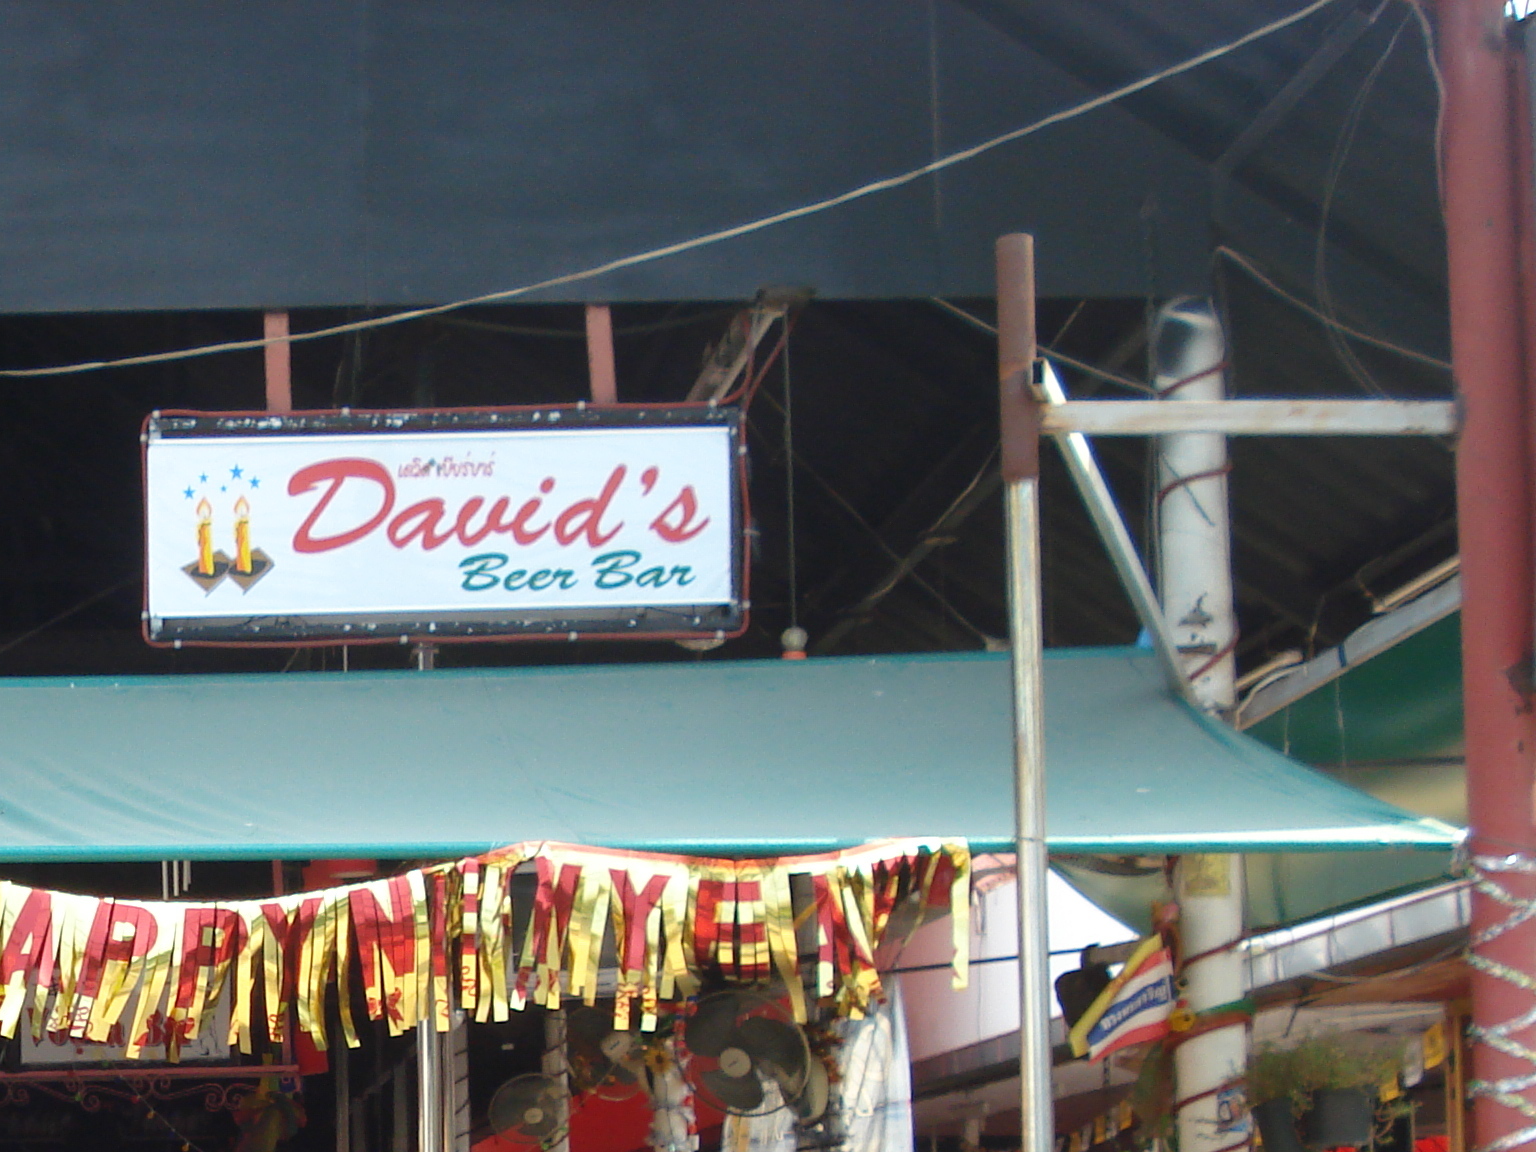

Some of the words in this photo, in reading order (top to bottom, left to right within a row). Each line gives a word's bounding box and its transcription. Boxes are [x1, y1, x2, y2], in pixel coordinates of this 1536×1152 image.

[287, 456, 711, 554] David's
[459, 551, 578, 592] Beer
[590, 549, 696, 589] Bar
